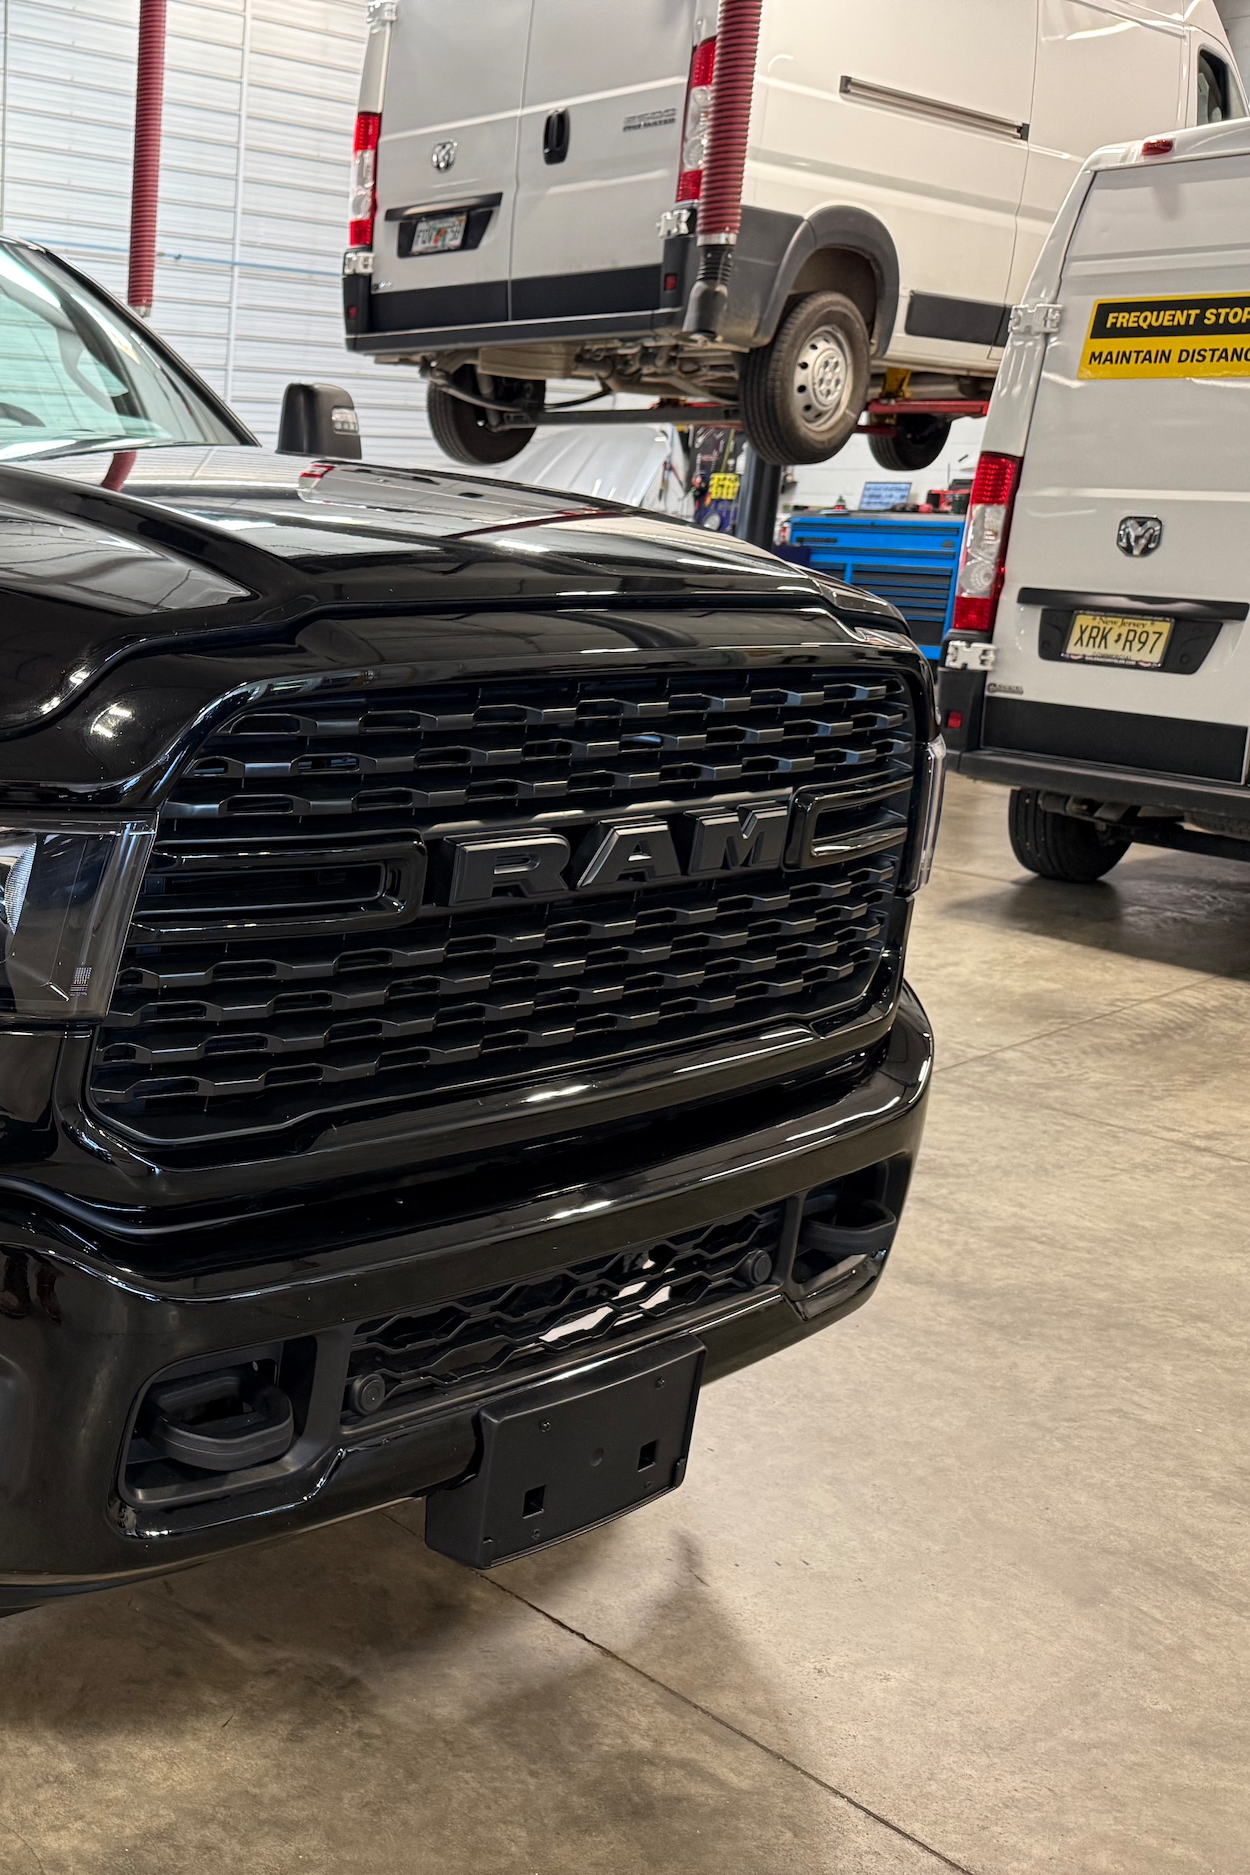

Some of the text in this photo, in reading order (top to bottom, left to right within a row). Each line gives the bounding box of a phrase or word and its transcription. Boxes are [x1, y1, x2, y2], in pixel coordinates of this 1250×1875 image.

[1106, 308, 1200, 330] FREQUENT
[1088, 349, 1172, 365] MAINTAIN
[1098, 617, 1147, 629] New Jersey
[1073, 624, 1164, 654] XRK R97
[445, 799, 790, 906] RAM
